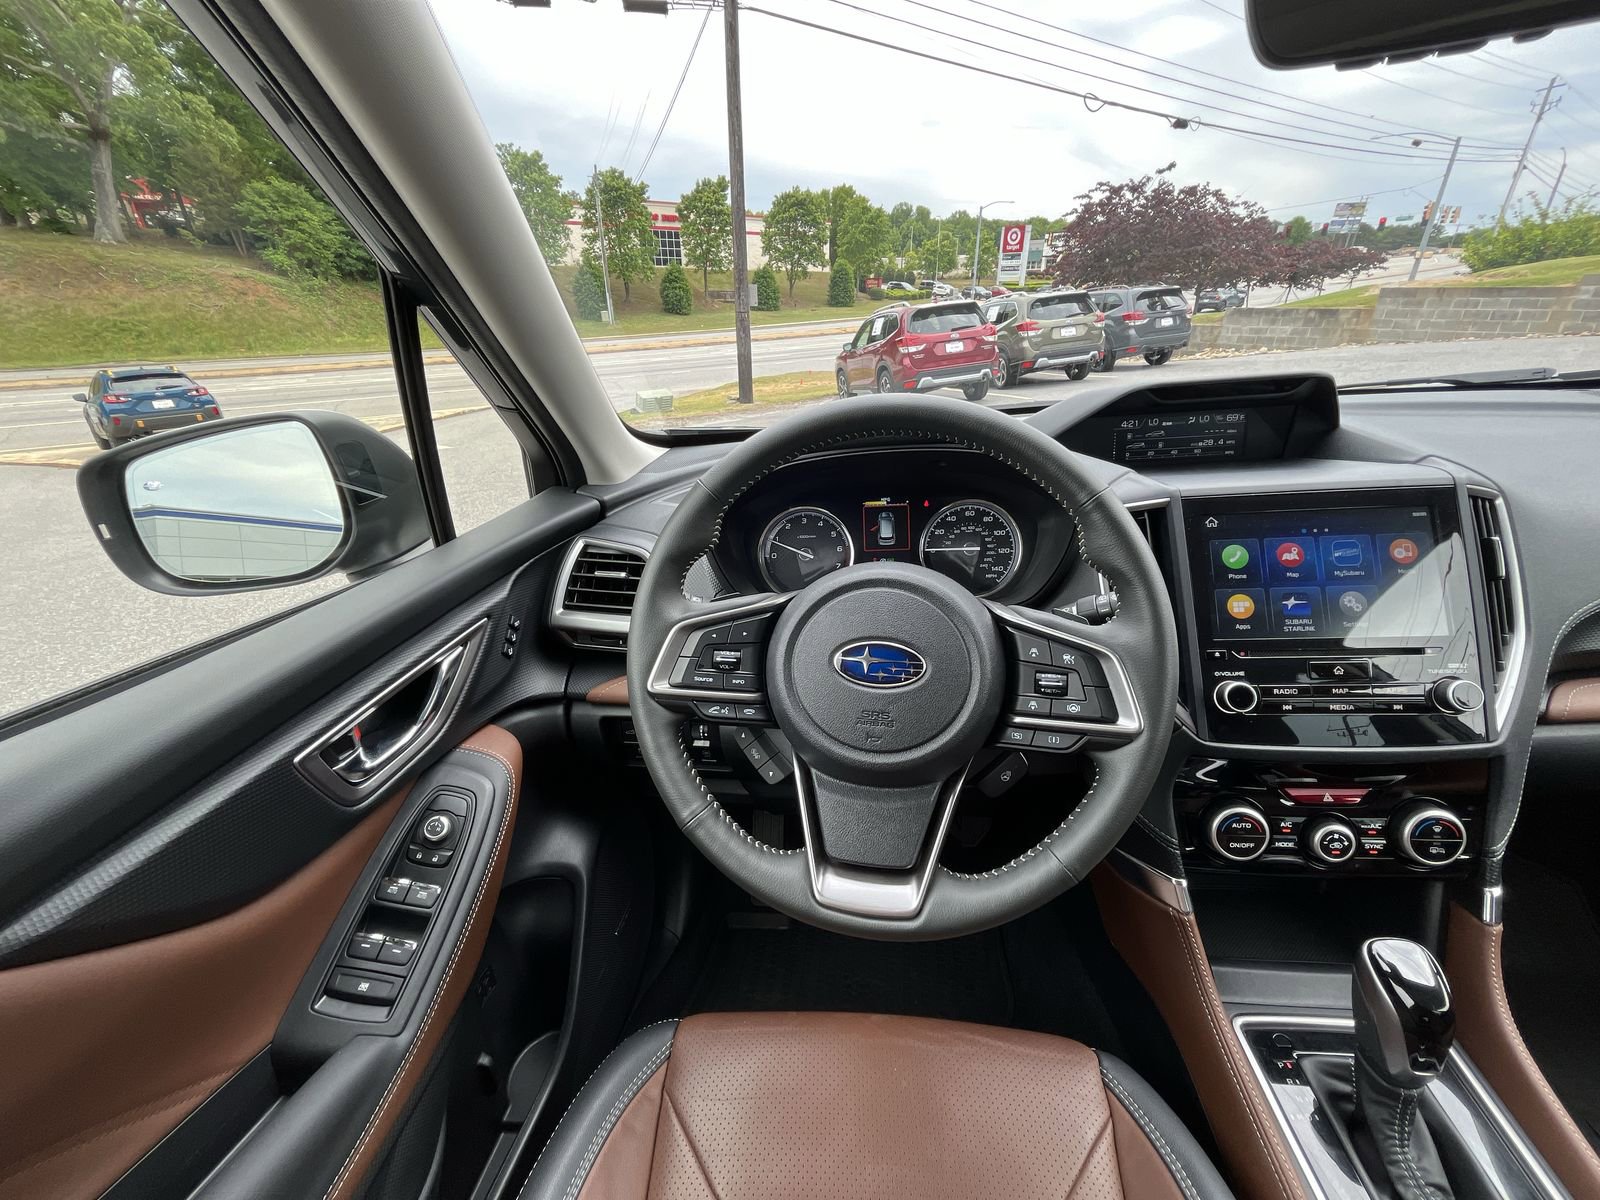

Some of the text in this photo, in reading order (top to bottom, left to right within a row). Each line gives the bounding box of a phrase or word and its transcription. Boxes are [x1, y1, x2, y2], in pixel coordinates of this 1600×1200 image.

[1148, 418, 1159, 426] LO
[1199, 415, 1210, 423] LO
[1121, 420, 1138, 428] 4:21
[830, 530, 837, 538] 5
[861, 710, 890, 720] SRS
[856, 719, 895, 729] AIRBAG
[1277, 1061, 1284, 1069] P
